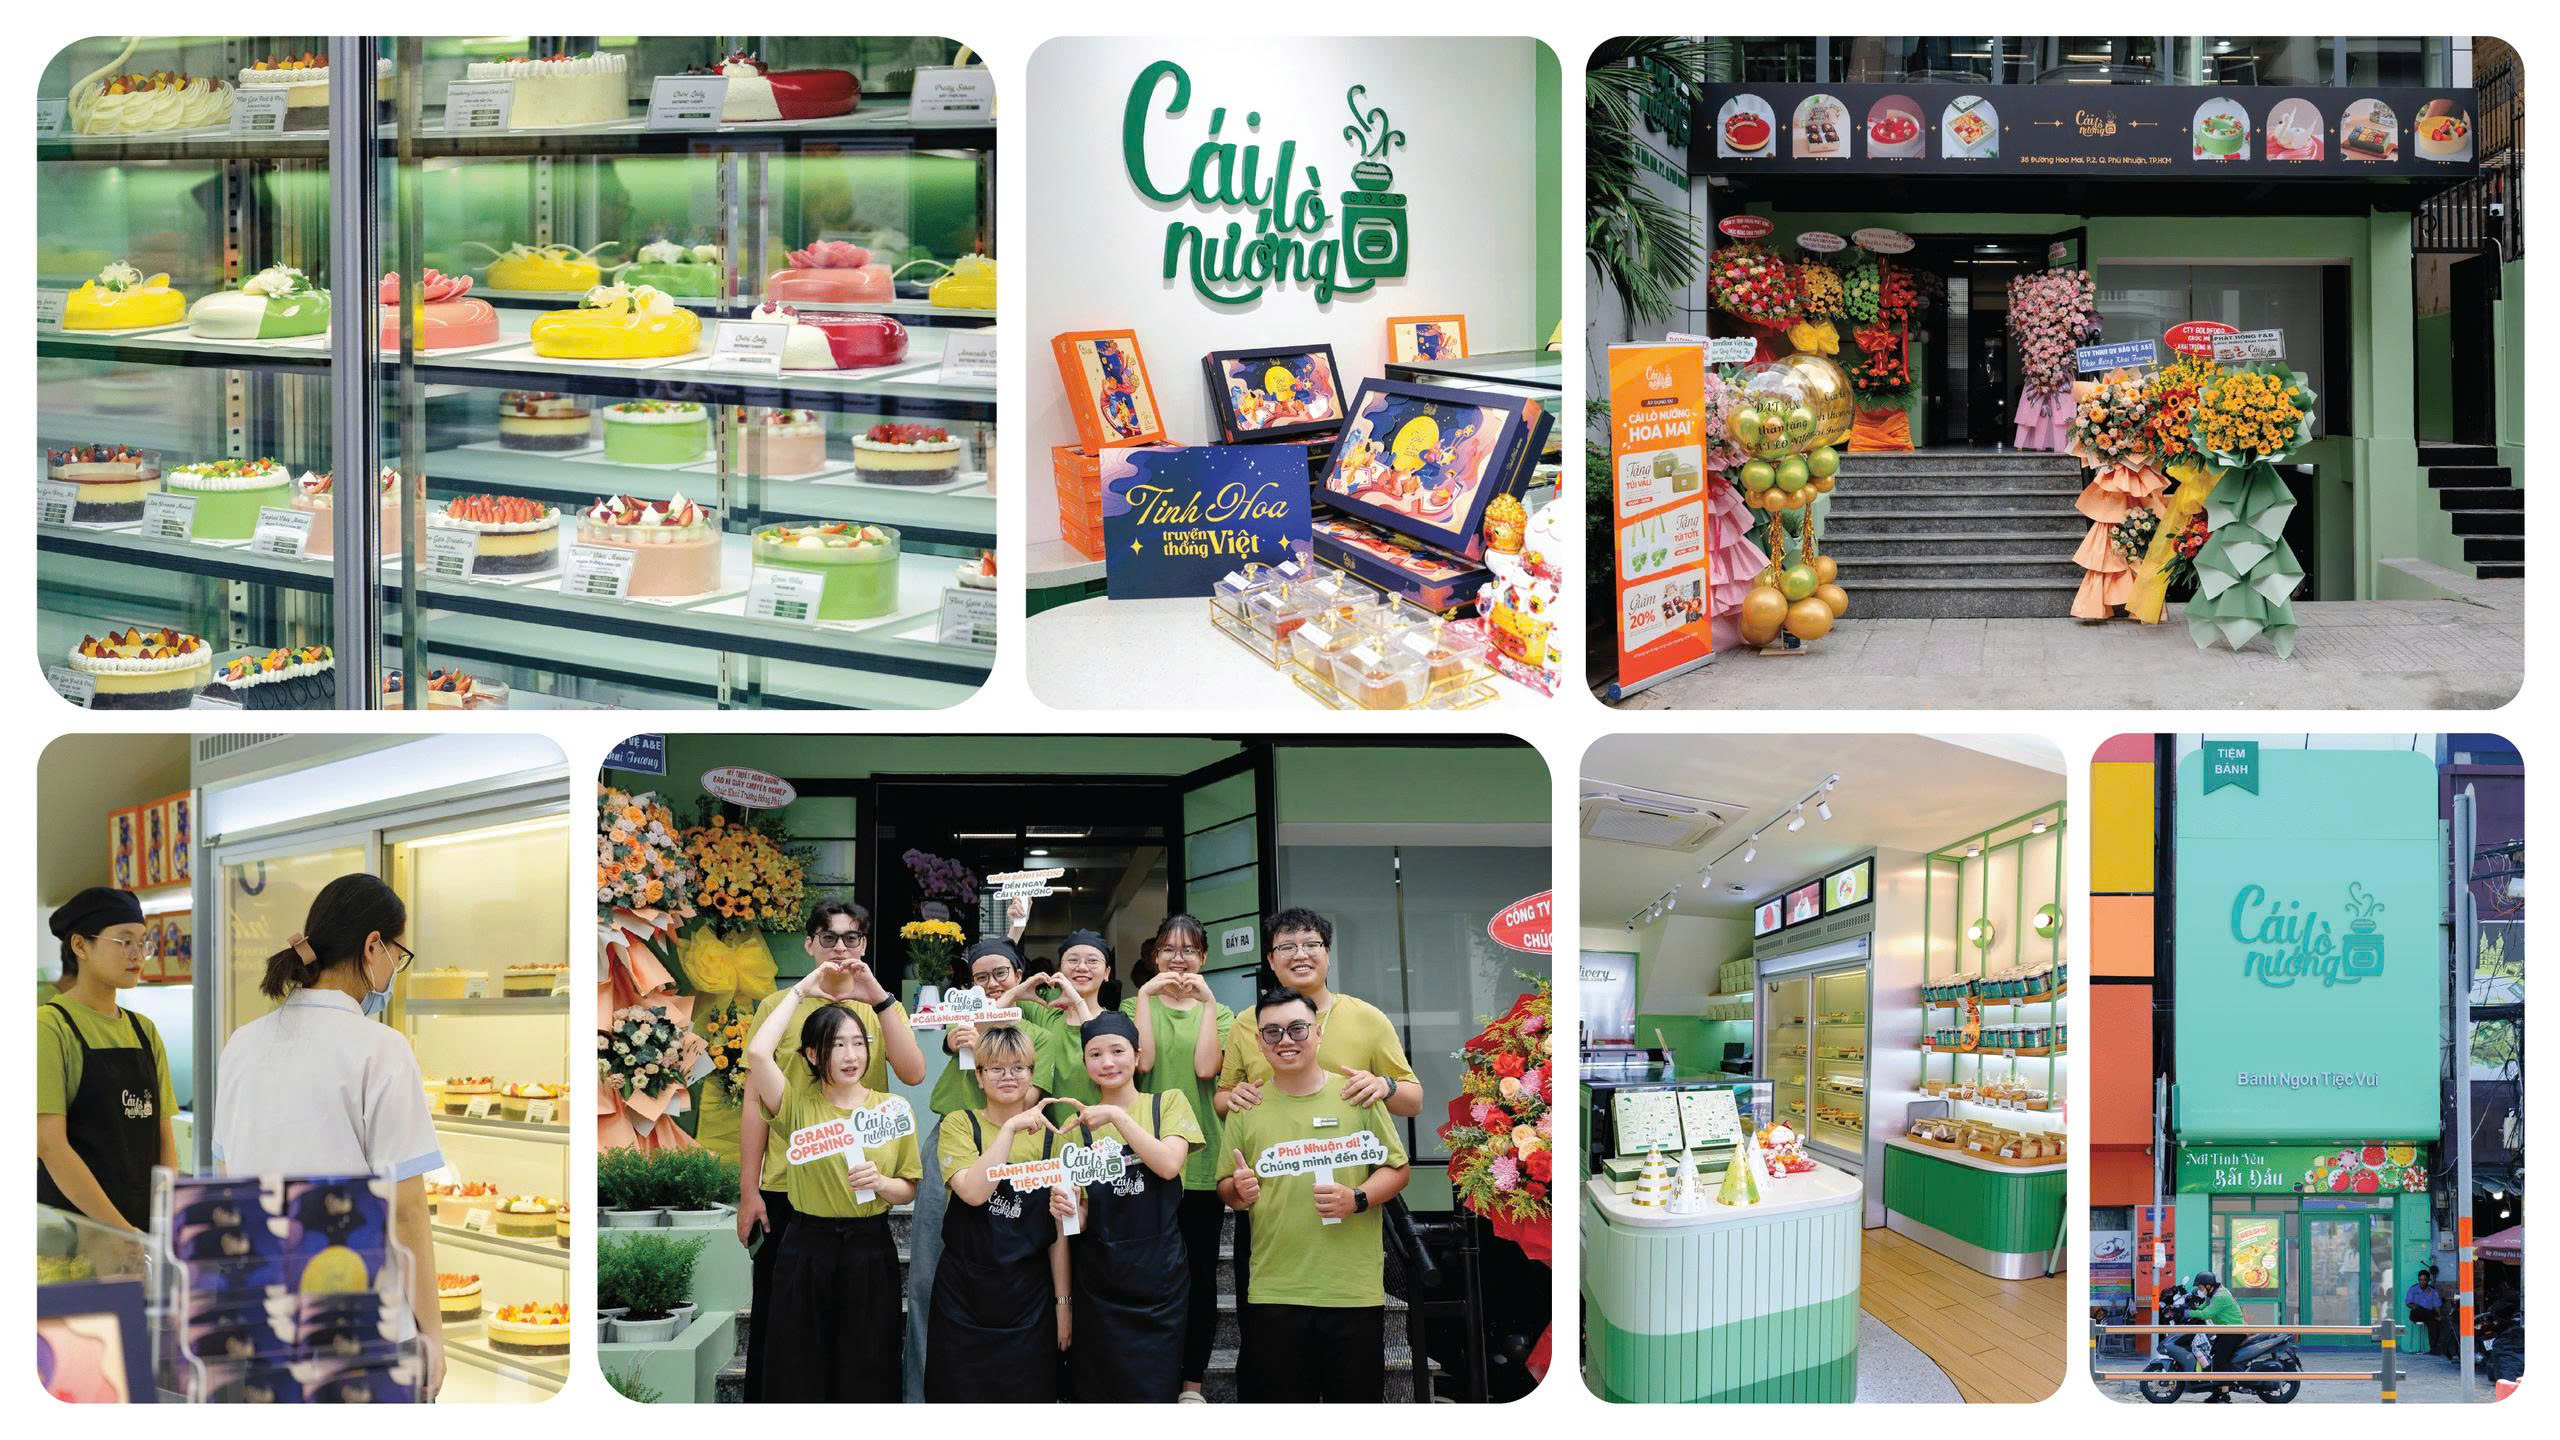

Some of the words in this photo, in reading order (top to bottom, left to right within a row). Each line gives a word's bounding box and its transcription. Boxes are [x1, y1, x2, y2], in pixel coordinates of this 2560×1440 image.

[1122, 60, 1274, 206] Cái
[1273, 140, 1334, 234] lò
[2020, 156, 2029, 164] 38
[2031, 155, 2054, 165] Đường
[2055, 156, 2069, 164] Hoa
[2107, 155, 2122, 164] Phú
[1162, 209, 1376, 305] nướng
[2183, 326, 2194, 334] CTY
[2079, 350, 2090, 358] CTY
[1629, 412, 1646, 425] CÁI
[1647, 411, 1658, 422] LÒ
[1659, 408, 1690, 421] NƯỚNG
[1629, 425, 1663, 443] HOA
[1665, 421, 1692, 438] MAI
[1125, 484, 1204, 527] Tinh
[1204, 482, 1291, 523] Hoa
[1162, 528, 1208, 543] truyền
[1207, 529, 1260, 560] Việt
[1163, 540, 1208, 559] thống
[1630, 611, 1656, 629] 20%
[629, 738, 640, 749] VỆ
[643, 739, 662, 750] A&E
[2217, 747, 2246, 761] TIỆM
[2215, 762, 2248, 775] BÁNH
[713, 776, 725, 784] BAO
[1022, 880, 1044, 888] NGAY
[995, 890, 1010, 899] CÁI
[1505, 905, 1536, 928] CÔNG
[1537, 900, 1551, 918] TY
[2231, 884, 2303, 944] Cái
[2302, 912, 2336, 956] lò
[1240, 934, 1250, 946] RA
[2244, 946, 2362, 988] nướng
[2238, 1072, 2277, 1086] Bánh
[2279, 1072, 2319, 1089] Ngon
[2321, 1071, 2354, 1090] Tiệc
[2354, 1071, 2380, 1086] Vui
[122, 1089, 135, 1107] Cái
[855, 1111, 880, 1133] Cái
[879, 1115, 893, 1130] lò
[794, 1122, 845, 1146] GRAND
[790, 1133, 855, 1161] OPENING
[1278, 1146, 1301, 1158] Phú
[1303, 1142, 1343, 1155] Nhuận
[1345, 1137, 1361, 1148] ơi!
[1063, 1145, 1091, 1169] Cái
[1091, 1154, 1103, 1170] lò
[1260, 1160, 1300, 1175] Chúng
[1335, 1150, 1358, 1164] đến
[1360, 1149, 1384, 1163] đây
[988, 1164, 1023, 1179] BÁNH
[1025, 1160, 1061, 1174] NGON
[1071, 1166, 1115, 1184] nướng
[1013, 1177, 1040, 1191] TIỆC
[1042, 1174, 1062, 1185] VUI
